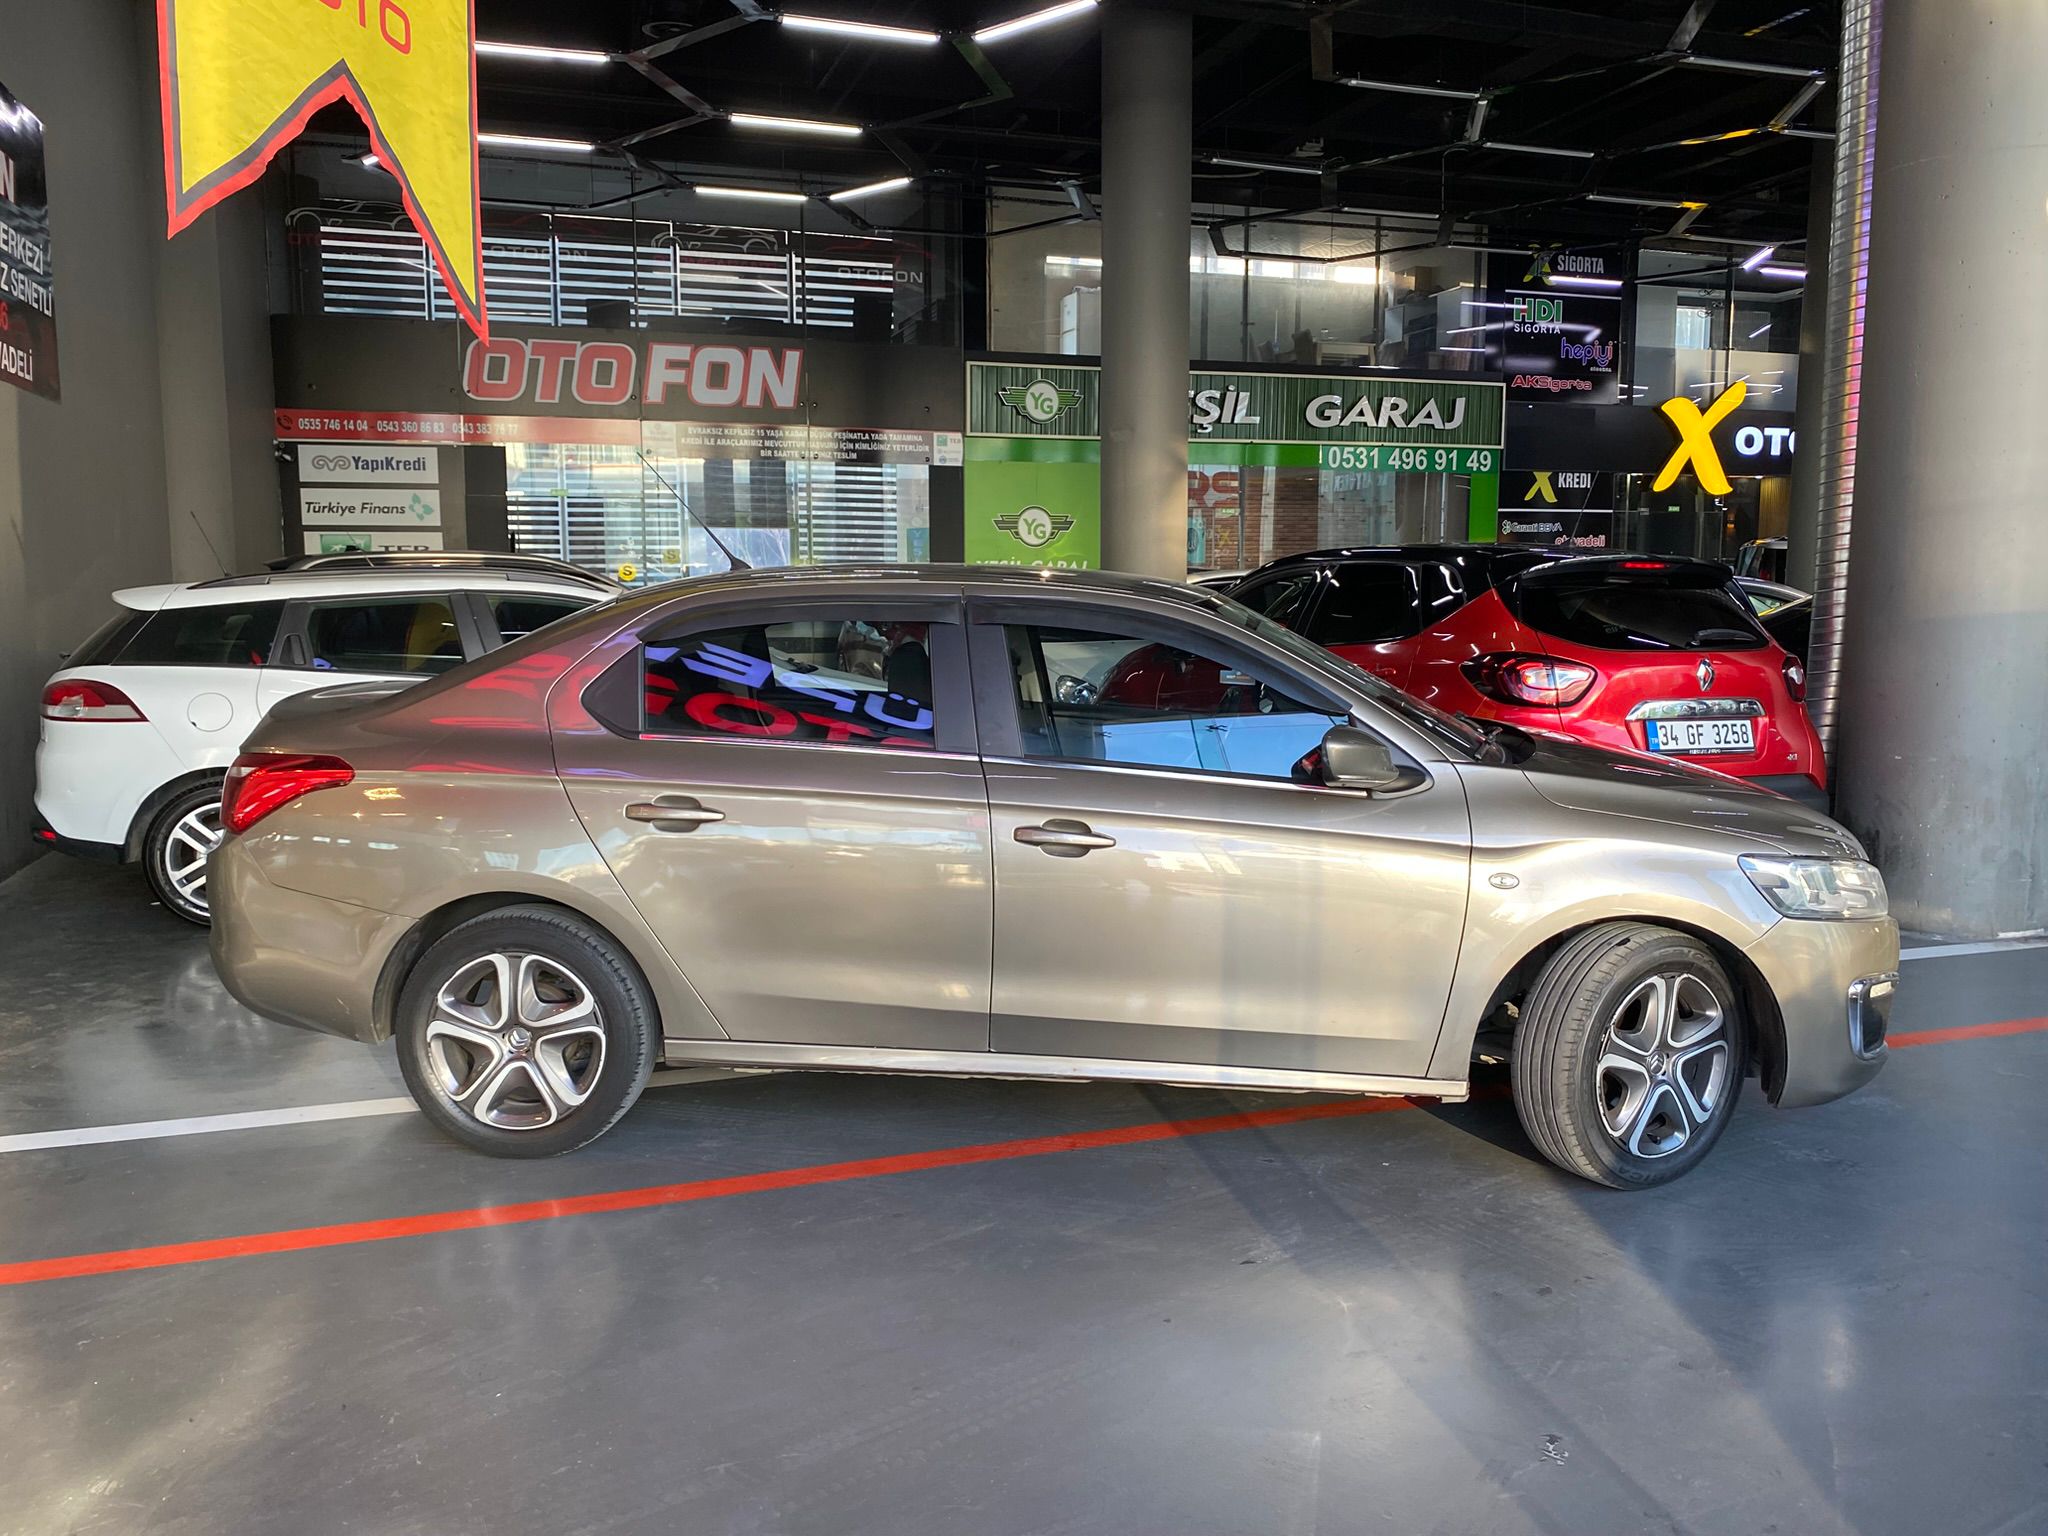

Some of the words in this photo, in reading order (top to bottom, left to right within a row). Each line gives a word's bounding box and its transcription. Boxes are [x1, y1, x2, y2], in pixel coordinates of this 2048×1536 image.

[0, 221, 43, 275] ERKEZİ
[1557, 250, 1605, 274] SİGORTA
[11, 268, 52, 317] SENETLİ
[1513, 297, 1563, 323] HDI
[1513, 323, 1561, 334] SİGORTA
[463, 337, 637, 405] OTO
[644, 341, 803, 409] FON
[1511, 374, 1593, 393] AKSigorta
[1029, 391, 1054, 415] YG
[1188, 384, 1260, 432] ŞİL
[1305, 394, 1466, 430] GARAJ
[298, 418, 321, 430] 0535
[323, 418, 341, 431] 746
[343, 419, 355, 431] 14
[356, 419, 368, 431] 04
[377, 420, 399, 432] 0543
[401, 421, 417, 433] 360
[1653, 380, 1747, 496] X
[1734, 426, 1795, 456] OT
[351, 455, 426, 473] YapıKredi
[1327, 446, 1379, 469] 0531
[1388, 448, 1427, 471] 496
[1434, 449, 1457, 471] 91
[1466, 450, 1492, 472] 49
[1558, 472, 1591, 489] KREDI
[304, 501, 356, 517] Türkiye
[360, 501, 406, 515] Finans
[1022, 517, 1047, 540] YG
[1659, 724, 1679, 746] 34
[1686, 724, 1704, 746] GF
[1712, 723, 1749, 745] 3258
